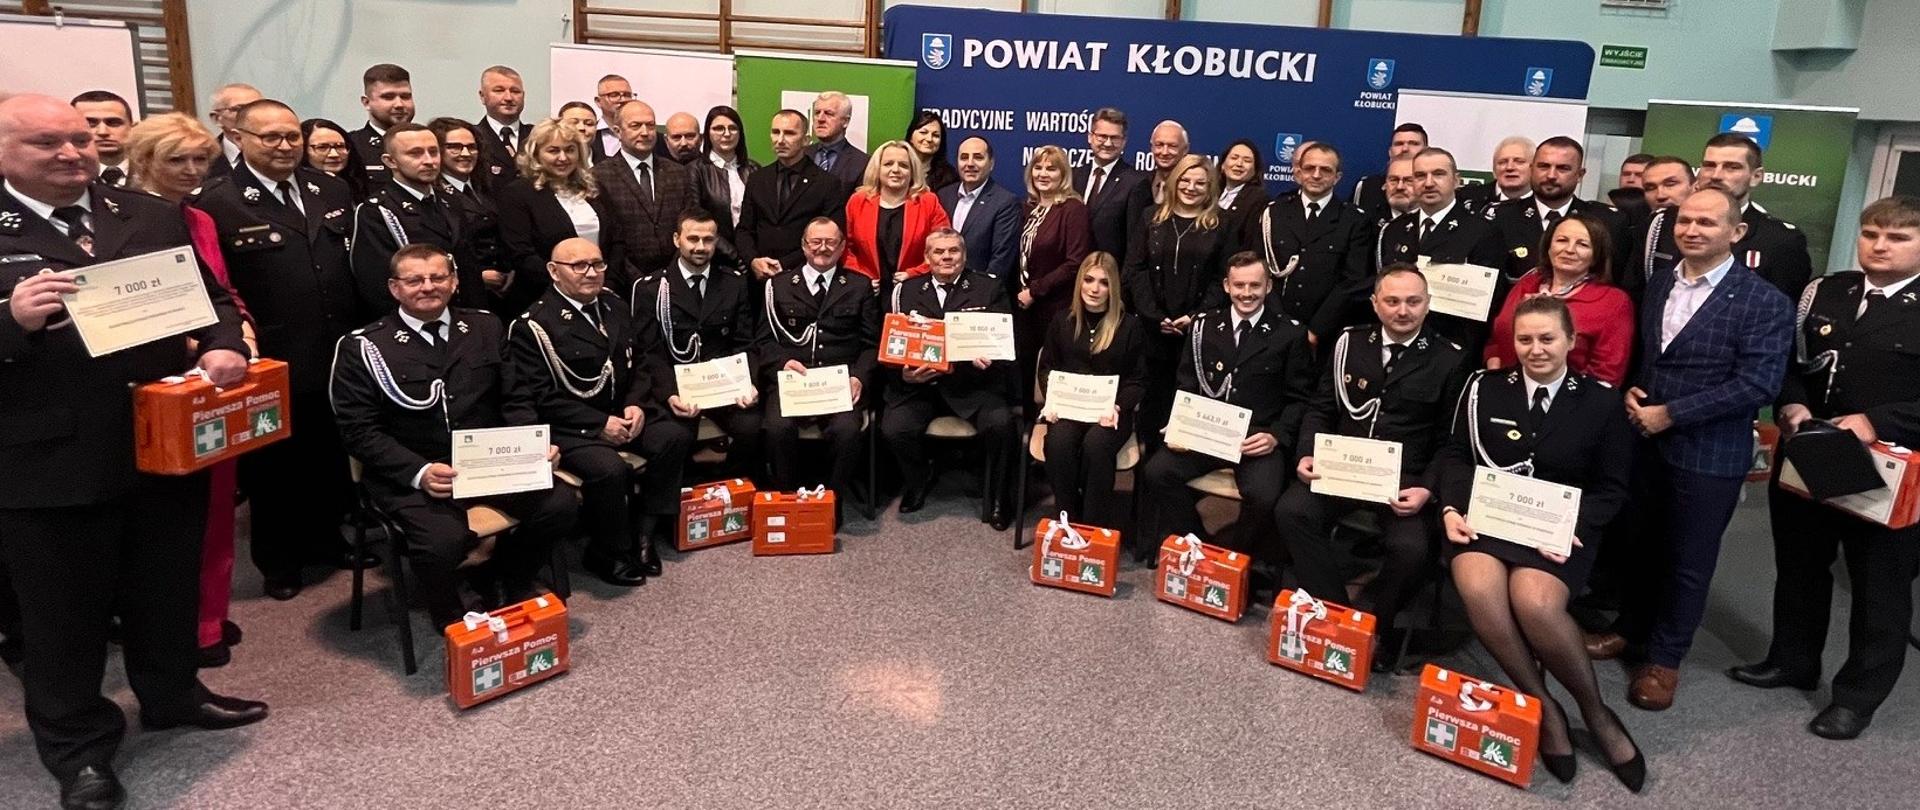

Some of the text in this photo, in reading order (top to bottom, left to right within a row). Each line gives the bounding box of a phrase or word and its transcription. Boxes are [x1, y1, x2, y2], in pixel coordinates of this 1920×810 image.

[963, 38, 1317, 83] POWIAT KŁOBUCKI
[1360, 91, 1393, 101] POWIAT
[1354, 100, 1396, 110] KŁOBUCKI
[922, 108, 1095, 133] ADYCYJNE WARTOŚC
[1269, 165, 1294, 173] POWI
[1762, 172, 1817, 187] BUCKI
[114, 286, 121, 295] 7
[125, 280, 148, 294] 000
[192, 390, 281, 423] Pierwsza Pomoc
[1517, 494, 1534, 505] 000
[471, 633, 558, 669] Pierwsza Pomoc
[1428, 706, 1521, 746] Pierwsza Pomoc
